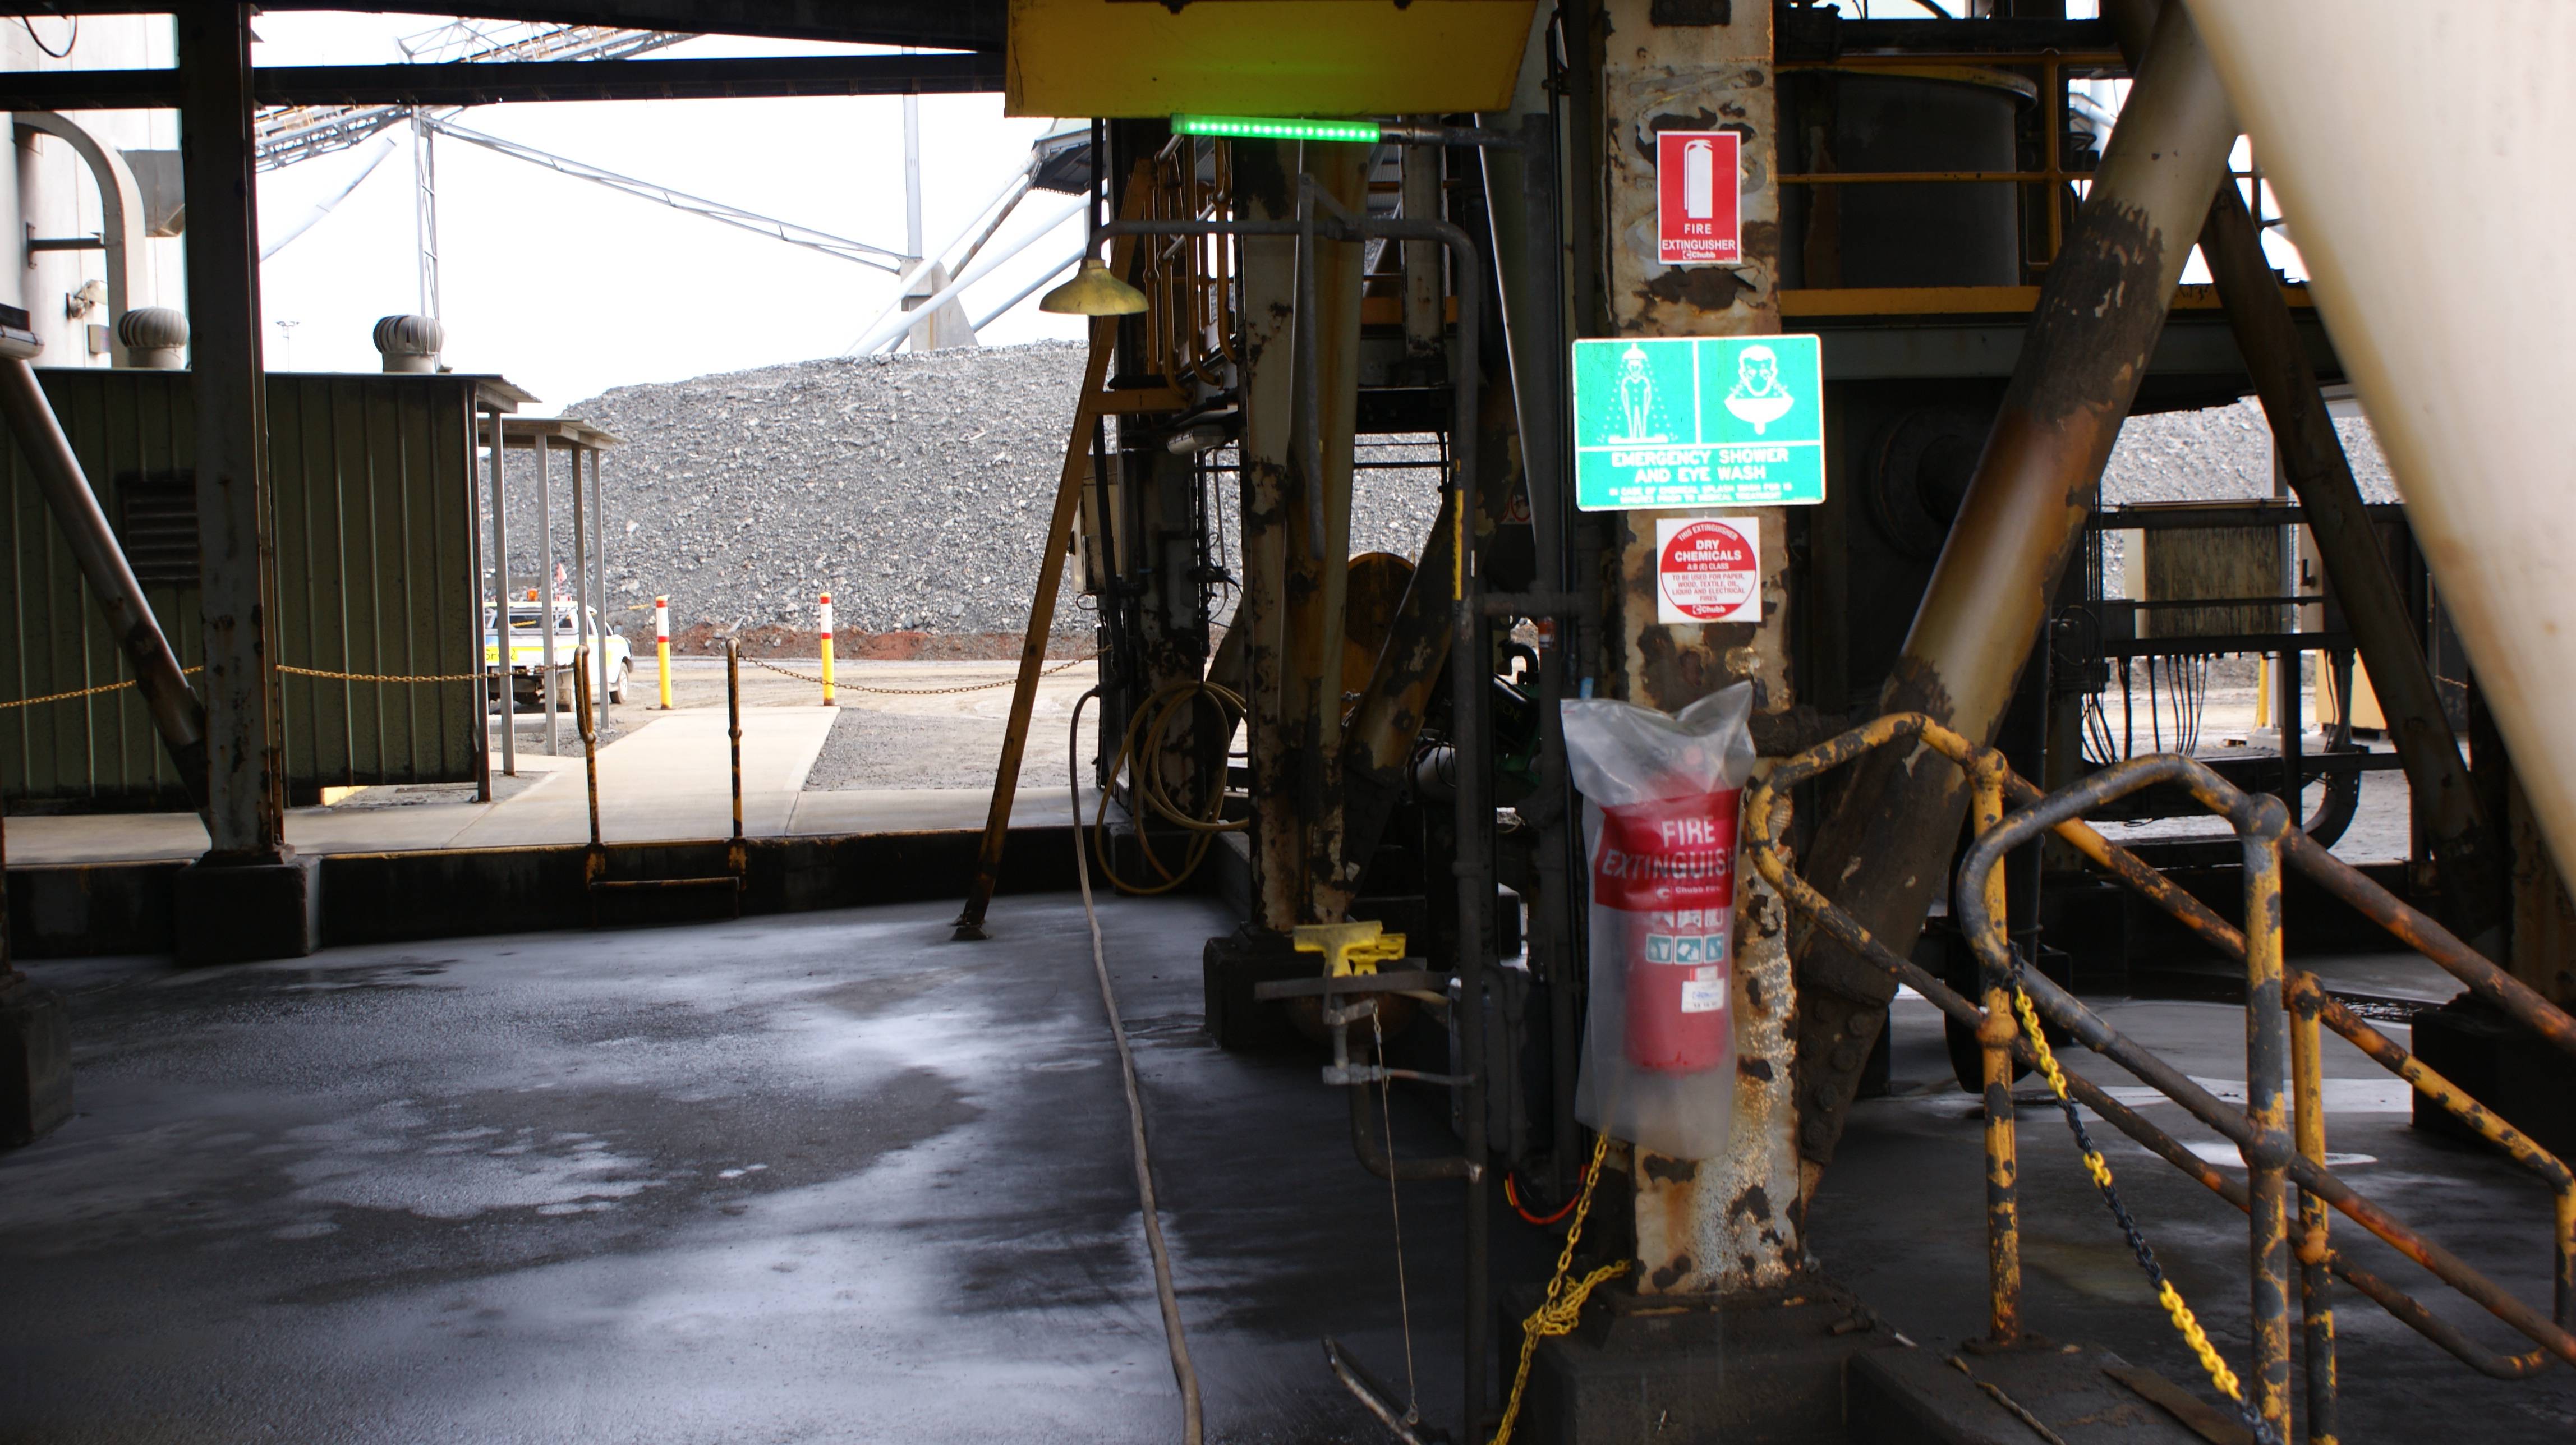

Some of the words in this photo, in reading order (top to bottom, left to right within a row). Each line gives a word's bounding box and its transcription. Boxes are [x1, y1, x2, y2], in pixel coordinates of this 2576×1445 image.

[1684, 223, 1712, 234] FIRE
[1662, 238, 1736, 250] EXTINGUISHER
[1611, 449, 1711, 467] EMERGENCY
[1718, 447, 1789, 464] SHOWER
[1635, 468, 1671, 484] AND
[1677, 467, 1711, 482] EYE
[1717, 465, 1767, 481] WASH
[1677, 528, 1693, 542] THIS
[1692, 524, 1738, 541] EXTINGUISHER
[1696, 539, 1719, 550] DRY
[1674, 550, 1742, 562] CHEMICALS
[1701, 605, 1726, 614] Chubb
[1662, 816, 1716, 848] FIRE
